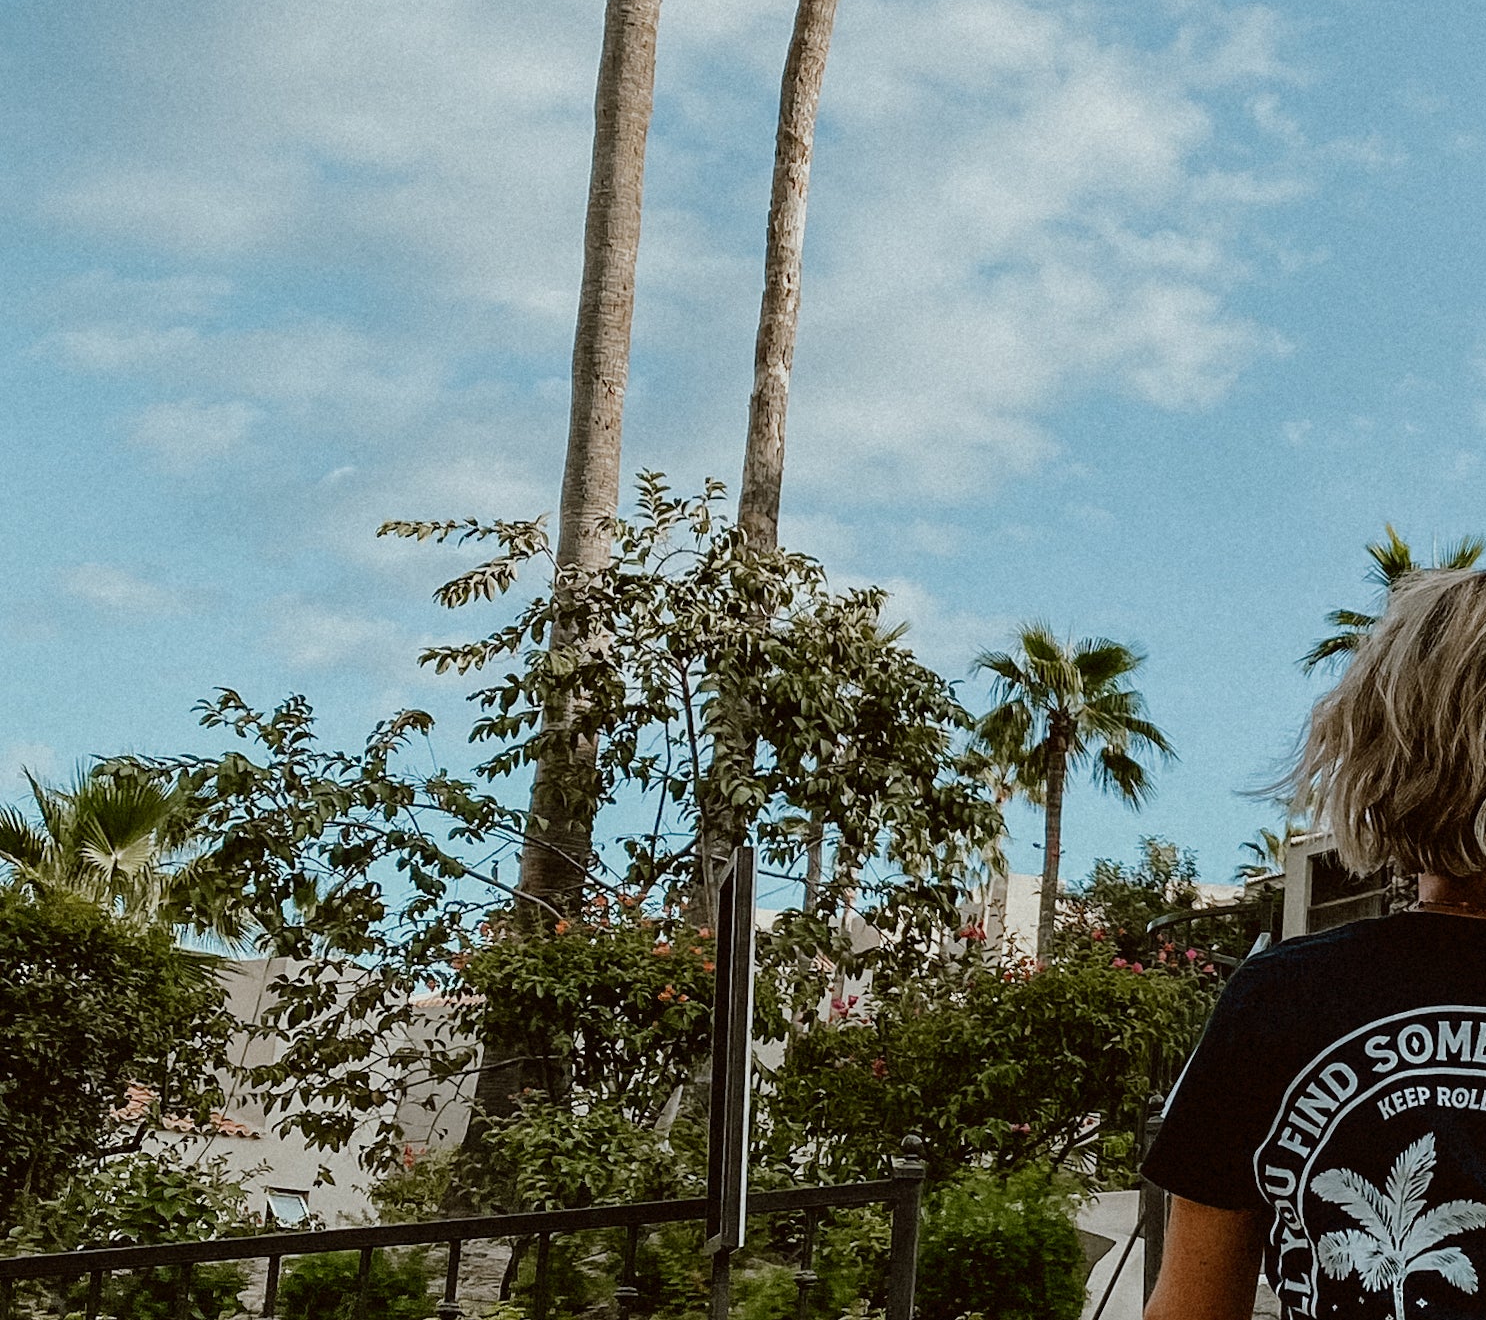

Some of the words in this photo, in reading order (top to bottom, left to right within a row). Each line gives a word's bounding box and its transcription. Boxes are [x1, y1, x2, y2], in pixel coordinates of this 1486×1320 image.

[1278, 1063, 1358, 1159] FIND
[1377, 1087, 1431, 1121] KEEP
[1265, 1164, 1309, 1256] YOU
[1285, 1272, 1312, 1317] LL
